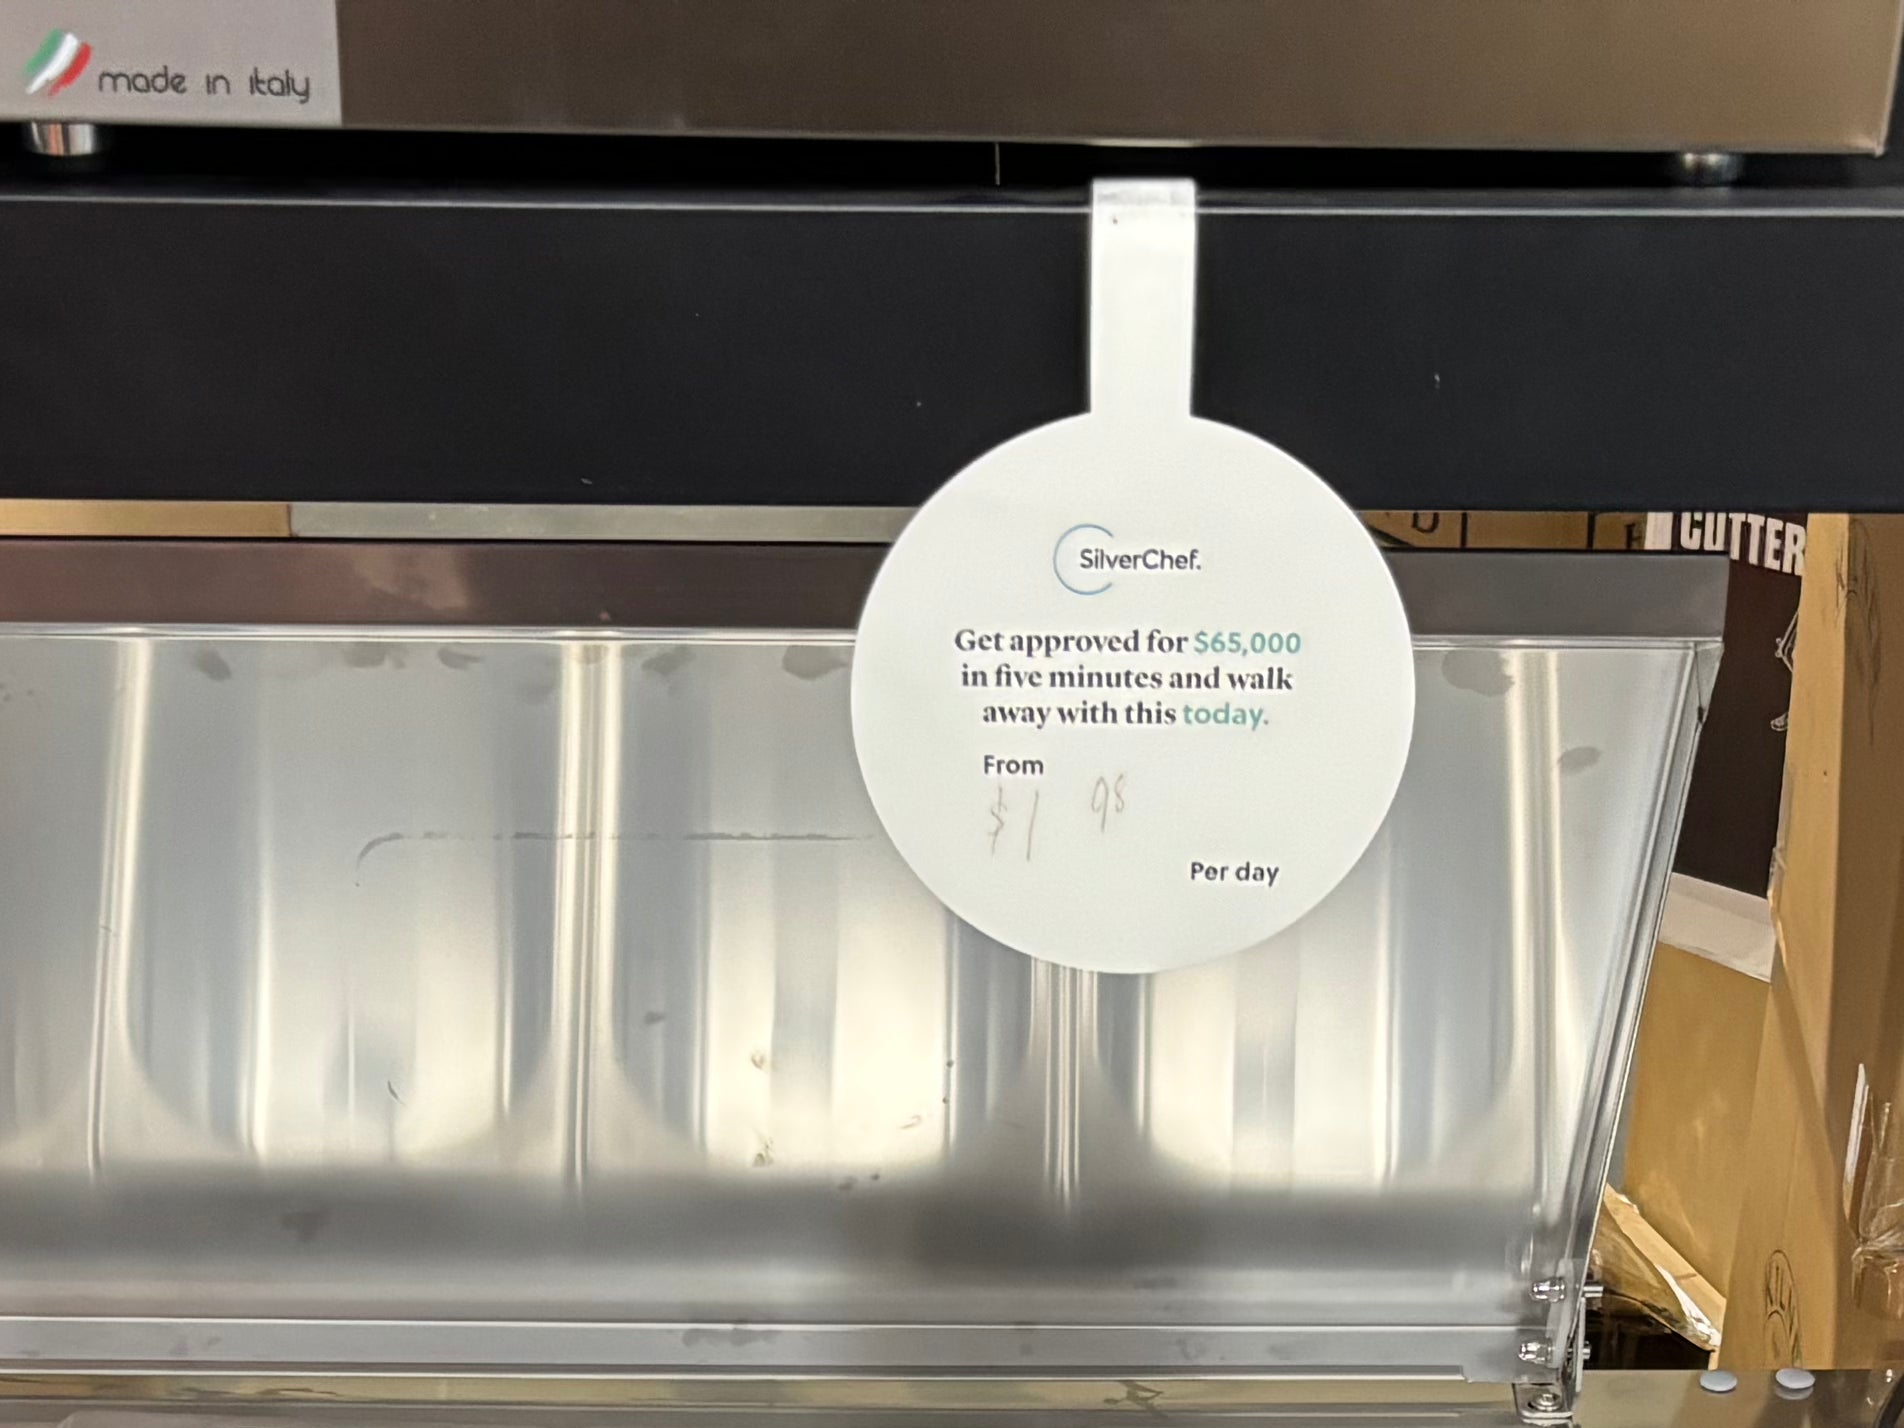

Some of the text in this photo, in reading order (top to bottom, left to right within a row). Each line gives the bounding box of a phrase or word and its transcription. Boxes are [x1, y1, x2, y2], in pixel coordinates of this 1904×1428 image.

[99, 68, 310, 103] made in italy
[1680, 512, 1806, 576] CUTTER
[954, 630, 1301, 657] Get approved for $65,000
[961, 665, 1293, 690] in five minutes and walk
[983, 702, 1268, 730] away with this today.
[984, 755, 1044, 775] From
[1190, 862, 1278, 886] Per day
